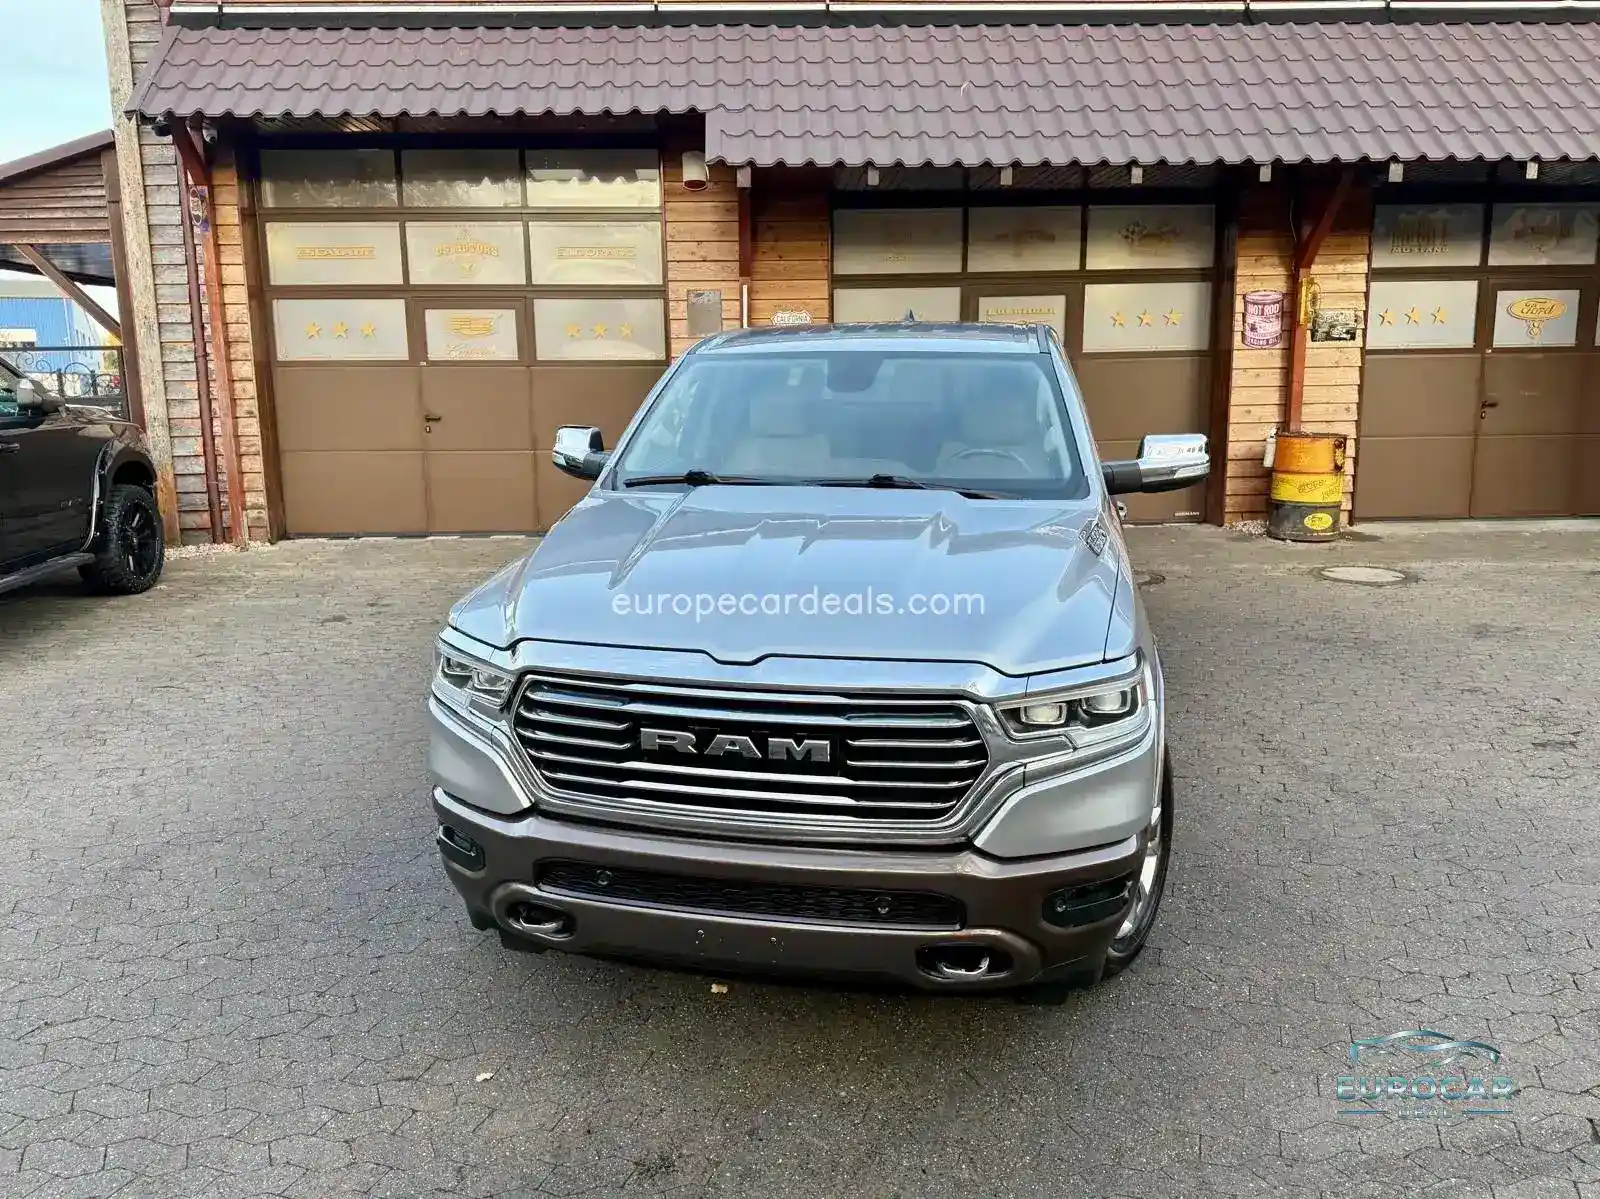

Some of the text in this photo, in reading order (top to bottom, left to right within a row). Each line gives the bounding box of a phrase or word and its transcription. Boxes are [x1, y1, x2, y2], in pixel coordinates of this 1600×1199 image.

[1246, 301, 1280, 316] HOT ROD
[1521, 300, 1556, 315] Ford
[640, 727, 830, 762] RAM
